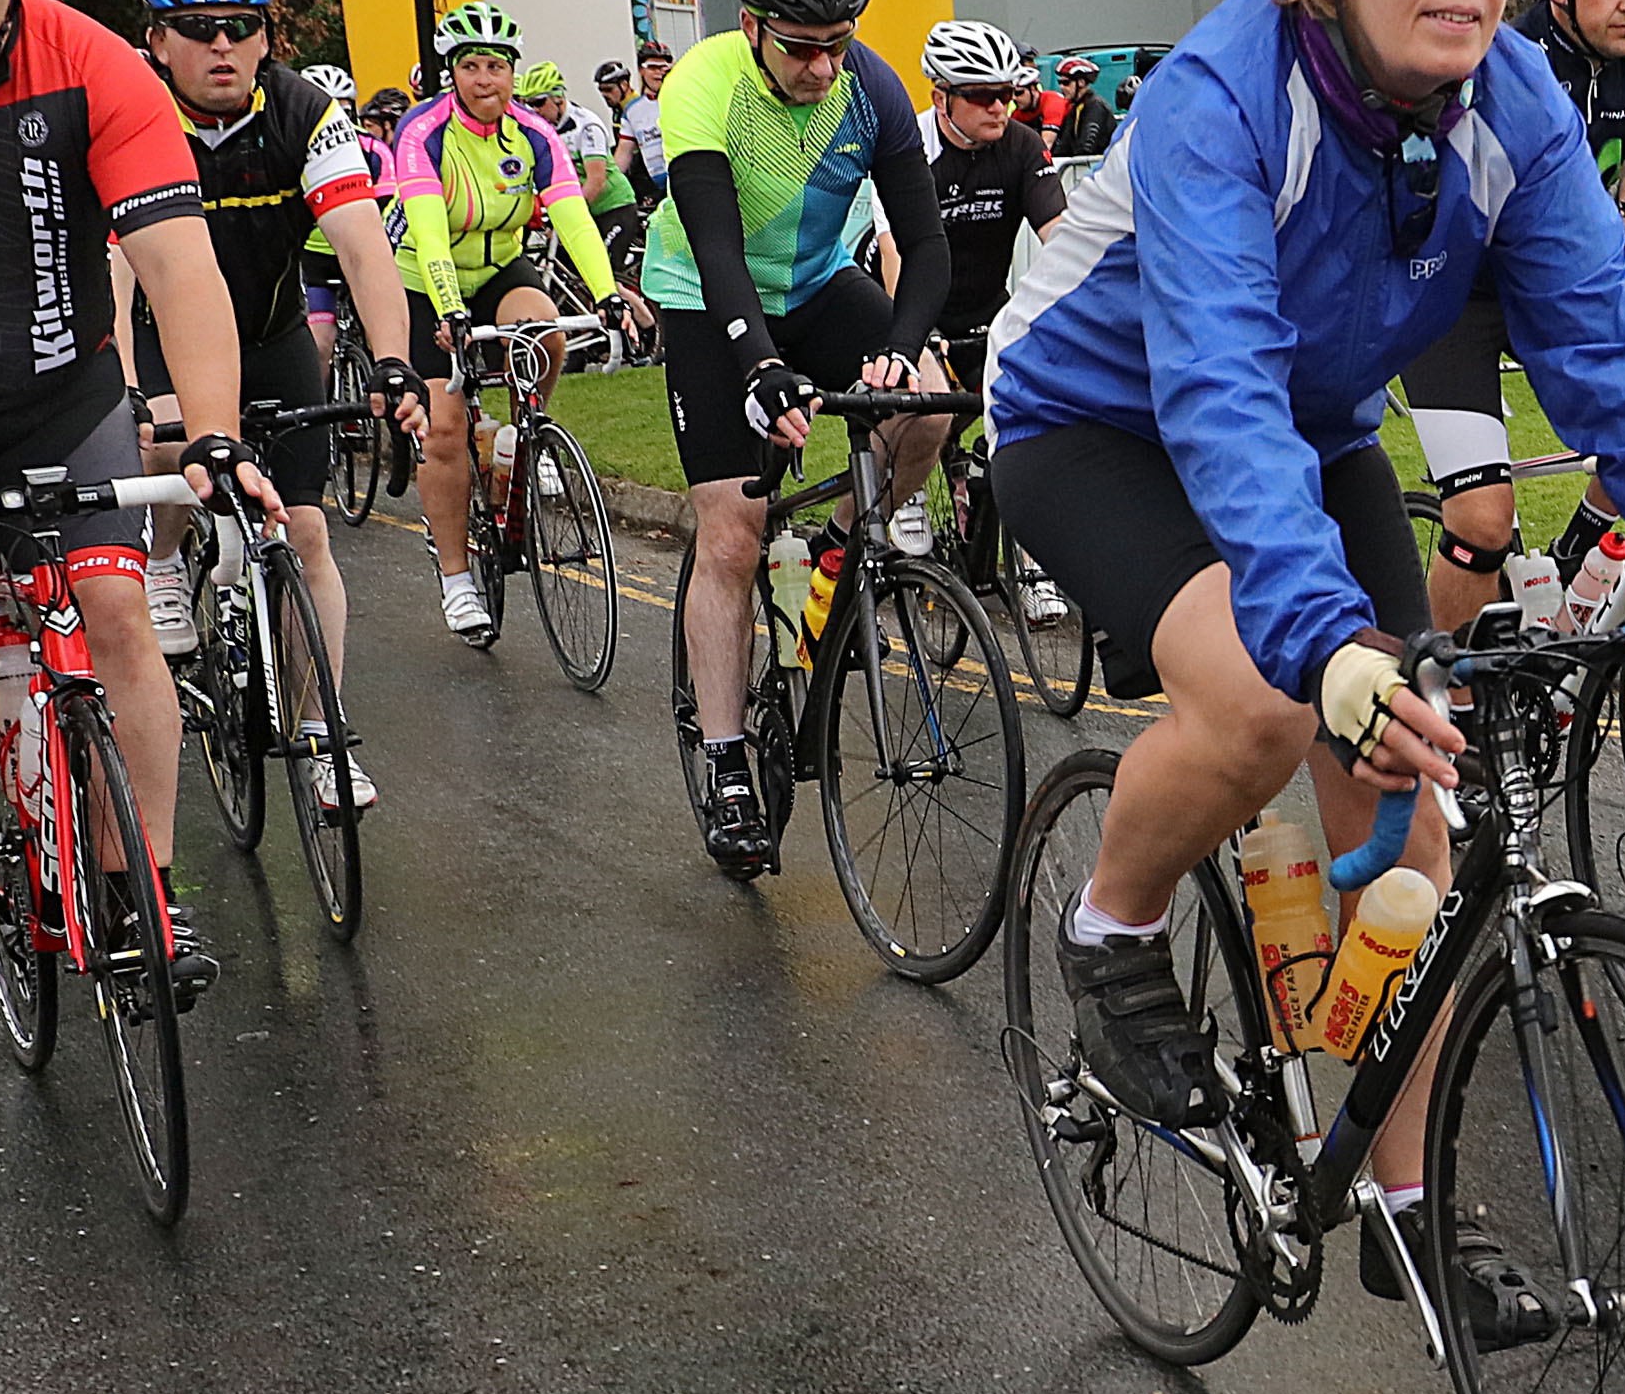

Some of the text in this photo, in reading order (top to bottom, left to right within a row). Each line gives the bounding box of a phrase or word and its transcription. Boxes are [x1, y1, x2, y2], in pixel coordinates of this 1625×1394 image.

[940, 200, 1004, 220] TREK
[19, 157, 76, 375] Kilworth
[1358, 931, 1414, 961] HIGH5
[1374, 889, 1465, 1064] TREK
[1289, 990, 1305, 1031] RACE
[1324, 979, 1361, 1049] HIGH5
[1352, 994, 1372, 1030] FASTER
